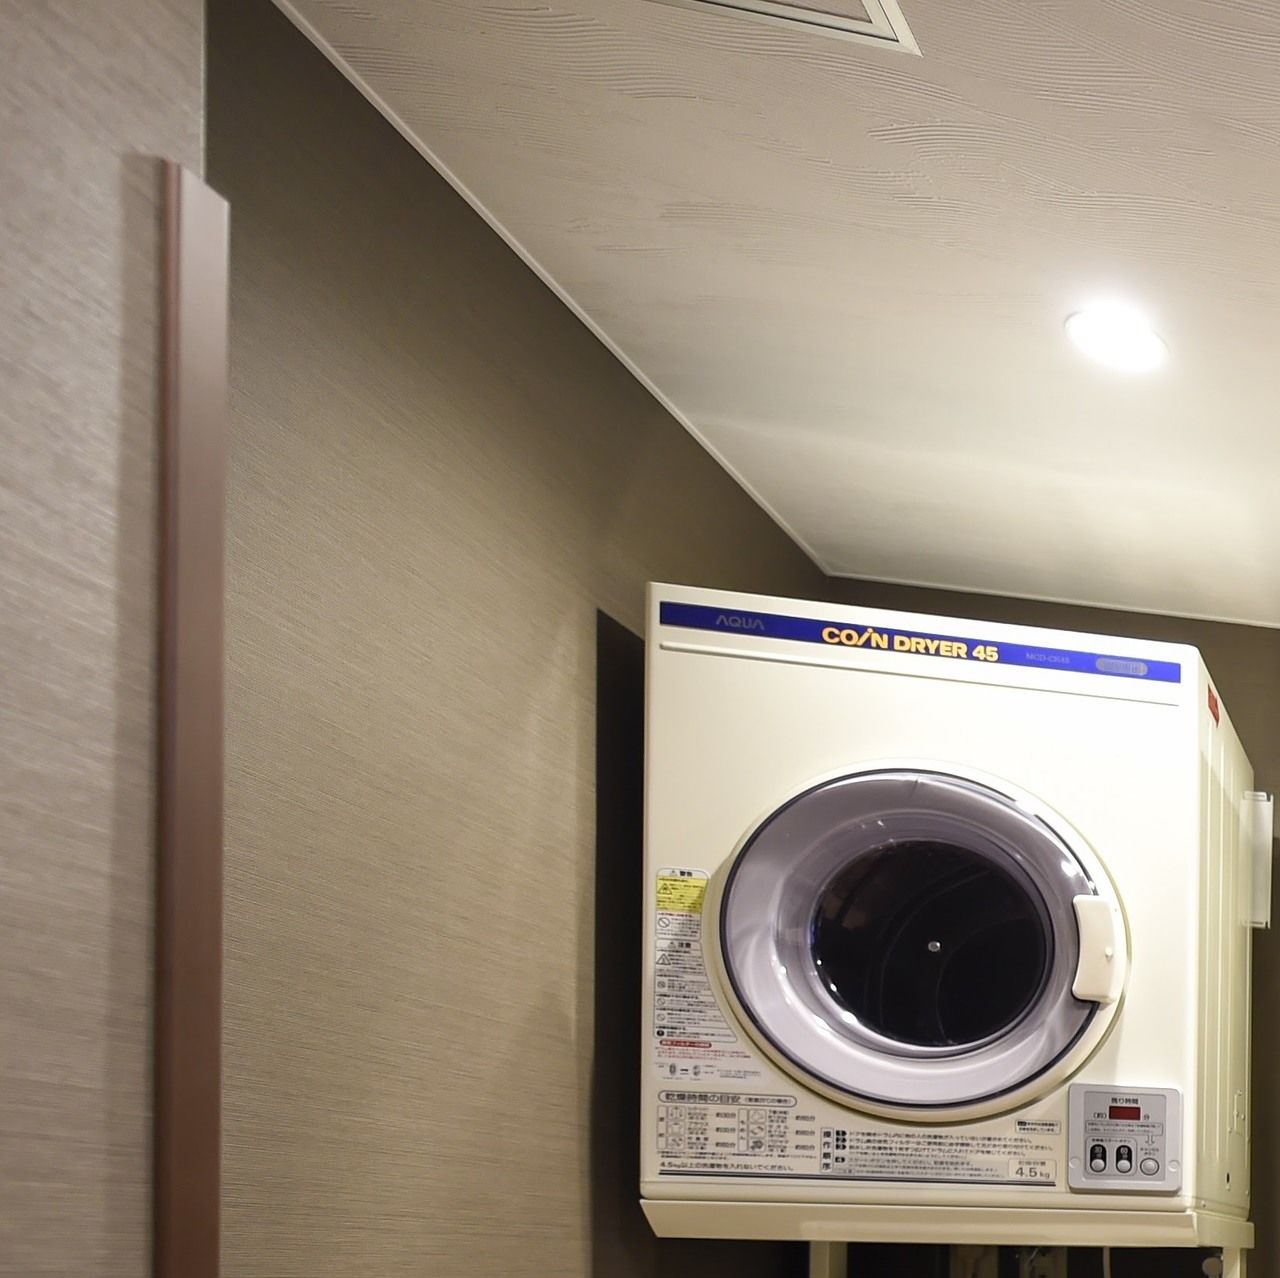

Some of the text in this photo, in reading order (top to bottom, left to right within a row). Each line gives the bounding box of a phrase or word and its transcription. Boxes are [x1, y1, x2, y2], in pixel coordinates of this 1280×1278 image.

[714, 614, 765, 631] AQUA
[893, 633, 968, 660] DRYER
[971, 645, 999, 662] 45
[1015, 1167, 1038, 1178] 4.5
